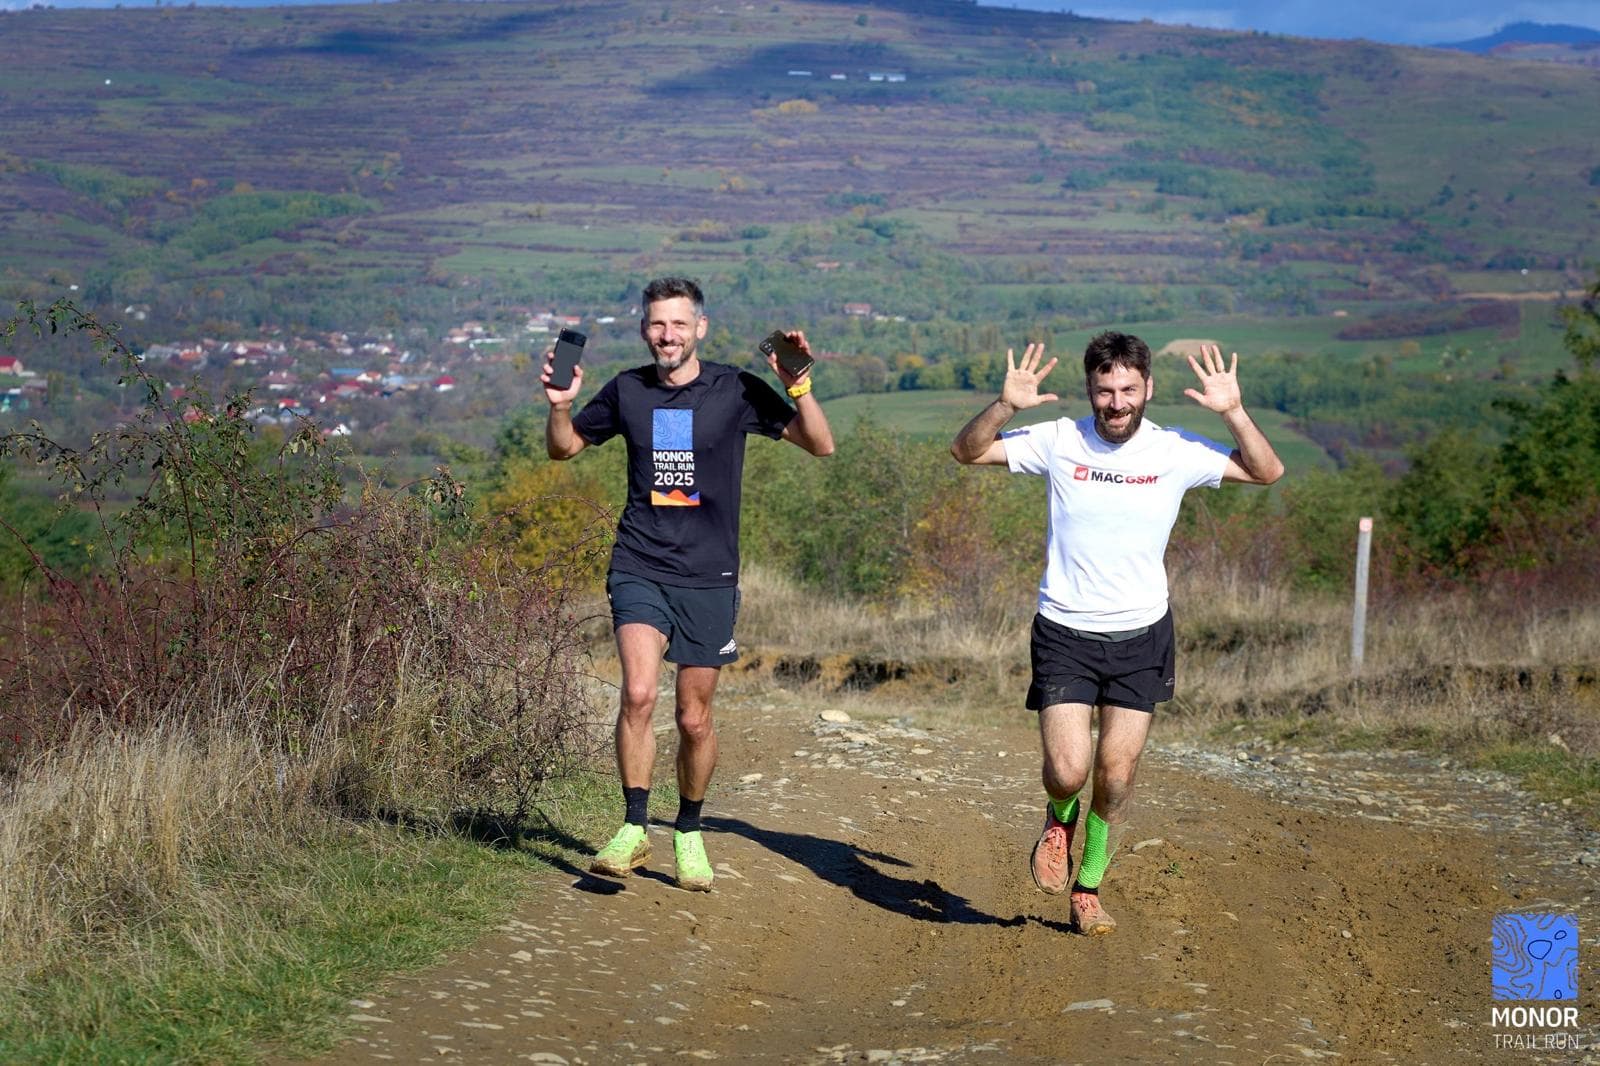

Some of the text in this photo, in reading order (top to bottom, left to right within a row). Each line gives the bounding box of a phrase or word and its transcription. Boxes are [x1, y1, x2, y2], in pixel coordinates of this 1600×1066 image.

[653, 451, 694, 462] MONOR
[654, 462, 695, 471] TRAIL RUN
[654, 471, 694, 486] 2025
